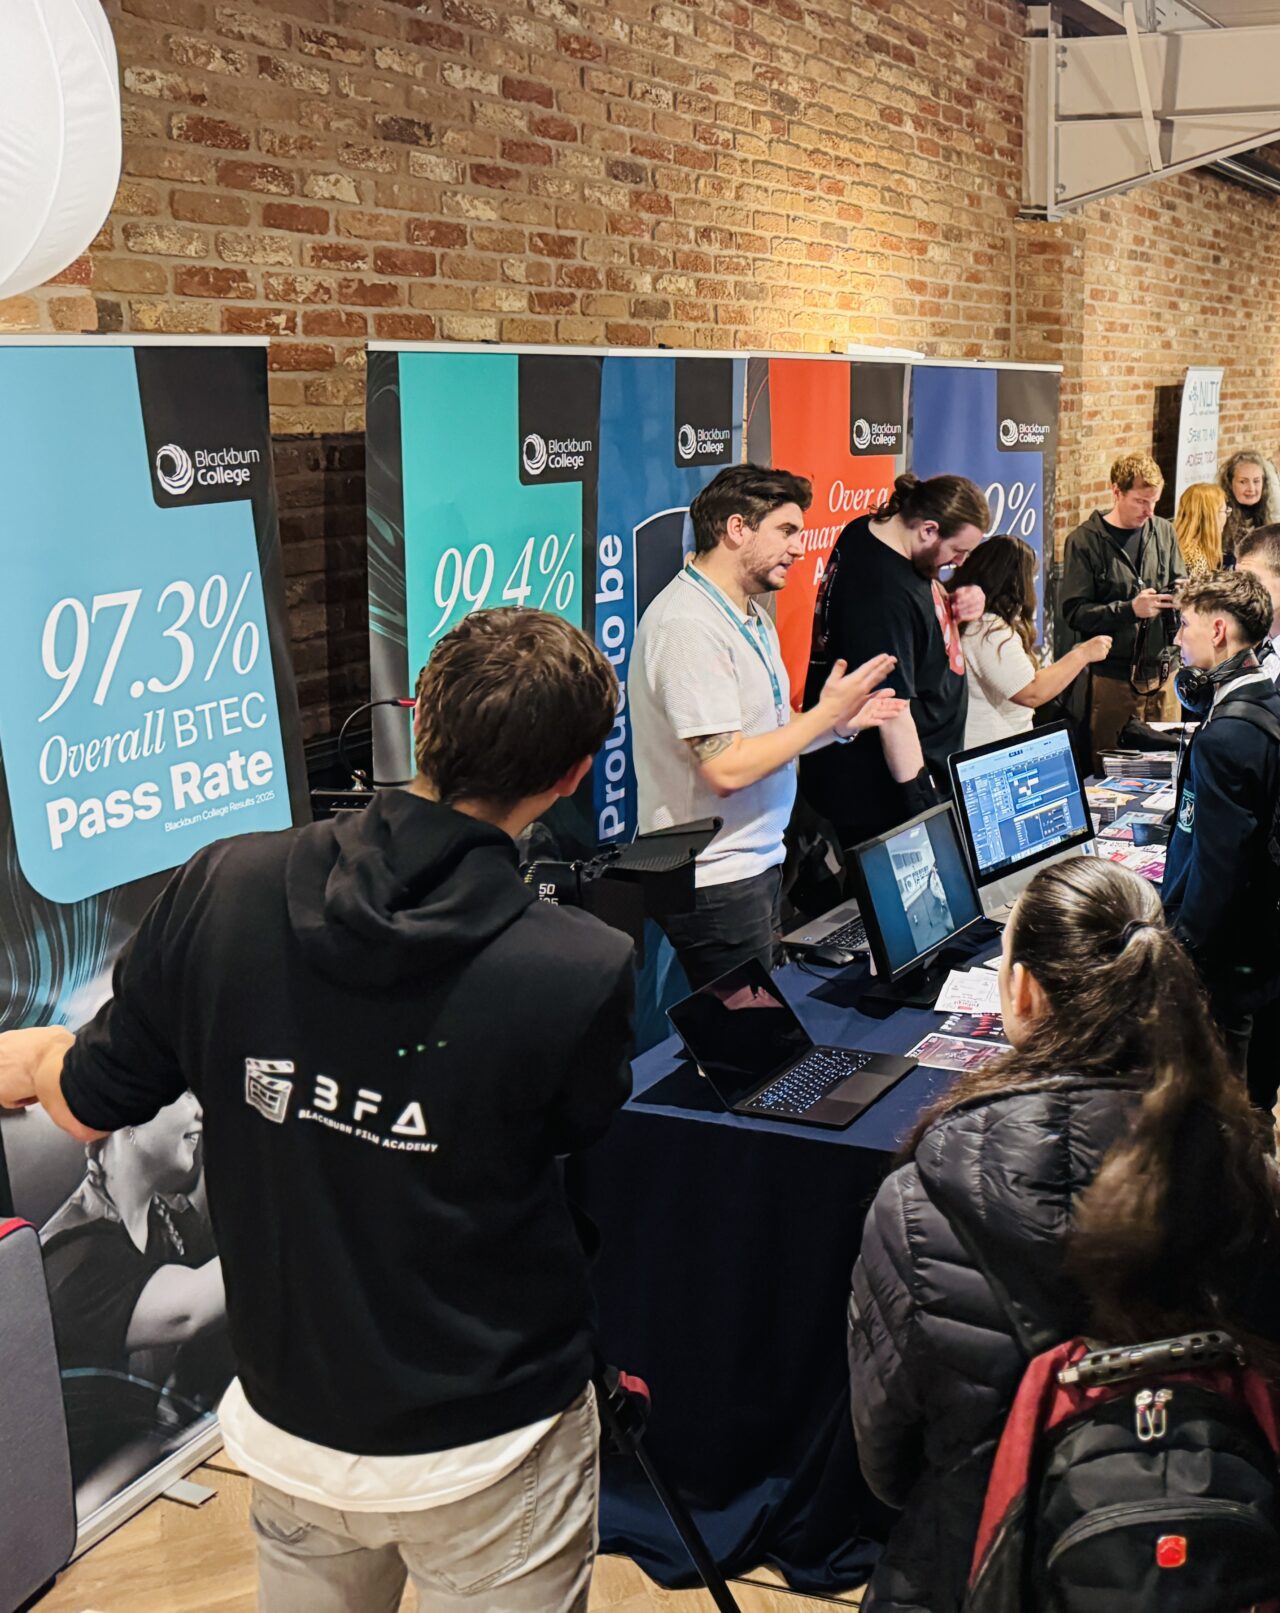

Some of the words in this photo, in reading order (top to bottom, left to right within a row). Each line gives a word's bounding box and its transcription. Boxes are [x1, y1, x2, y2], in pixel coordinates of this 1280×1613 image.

[697, 428, 731, 440] Blackburn
[872, 422, 901, 434] Blackburn
[1019, 423, 1050, 434] Blackburn
[548, 438, 592, 452] Blackburn
[871, 434, 896, 447] College
[1019, 433, 1044, 444] College
[697, 441, 724, 455] College
[194, 448, 260, 467] Blackburn
[548, 454, 584, 470] College
[197, 467, 250, 486] College
[829, 480, 875, 512] Over
[596, 534, 624, 604] be
[38, 571, 260, 723] 97.3%
[39, 707, 166, 785] Overall
[172, 691, 267, 749] BTEC
[46, 781, 162, 851] Pass
[169, 749, 273, 811] Rate
[164, 814, 202, 832] Blackburn
[202, 805, 230, 820] College
[230, 798, 256, 812] Results
[256, 790, 275, 804] 2025
[538, 883, 556, 895] 50
[298, 1109, 352, 1134] BLACKBURN
[355, 1128, 380, 1145] FILM
[382, 1138, 438, 1153] ACADEMY
